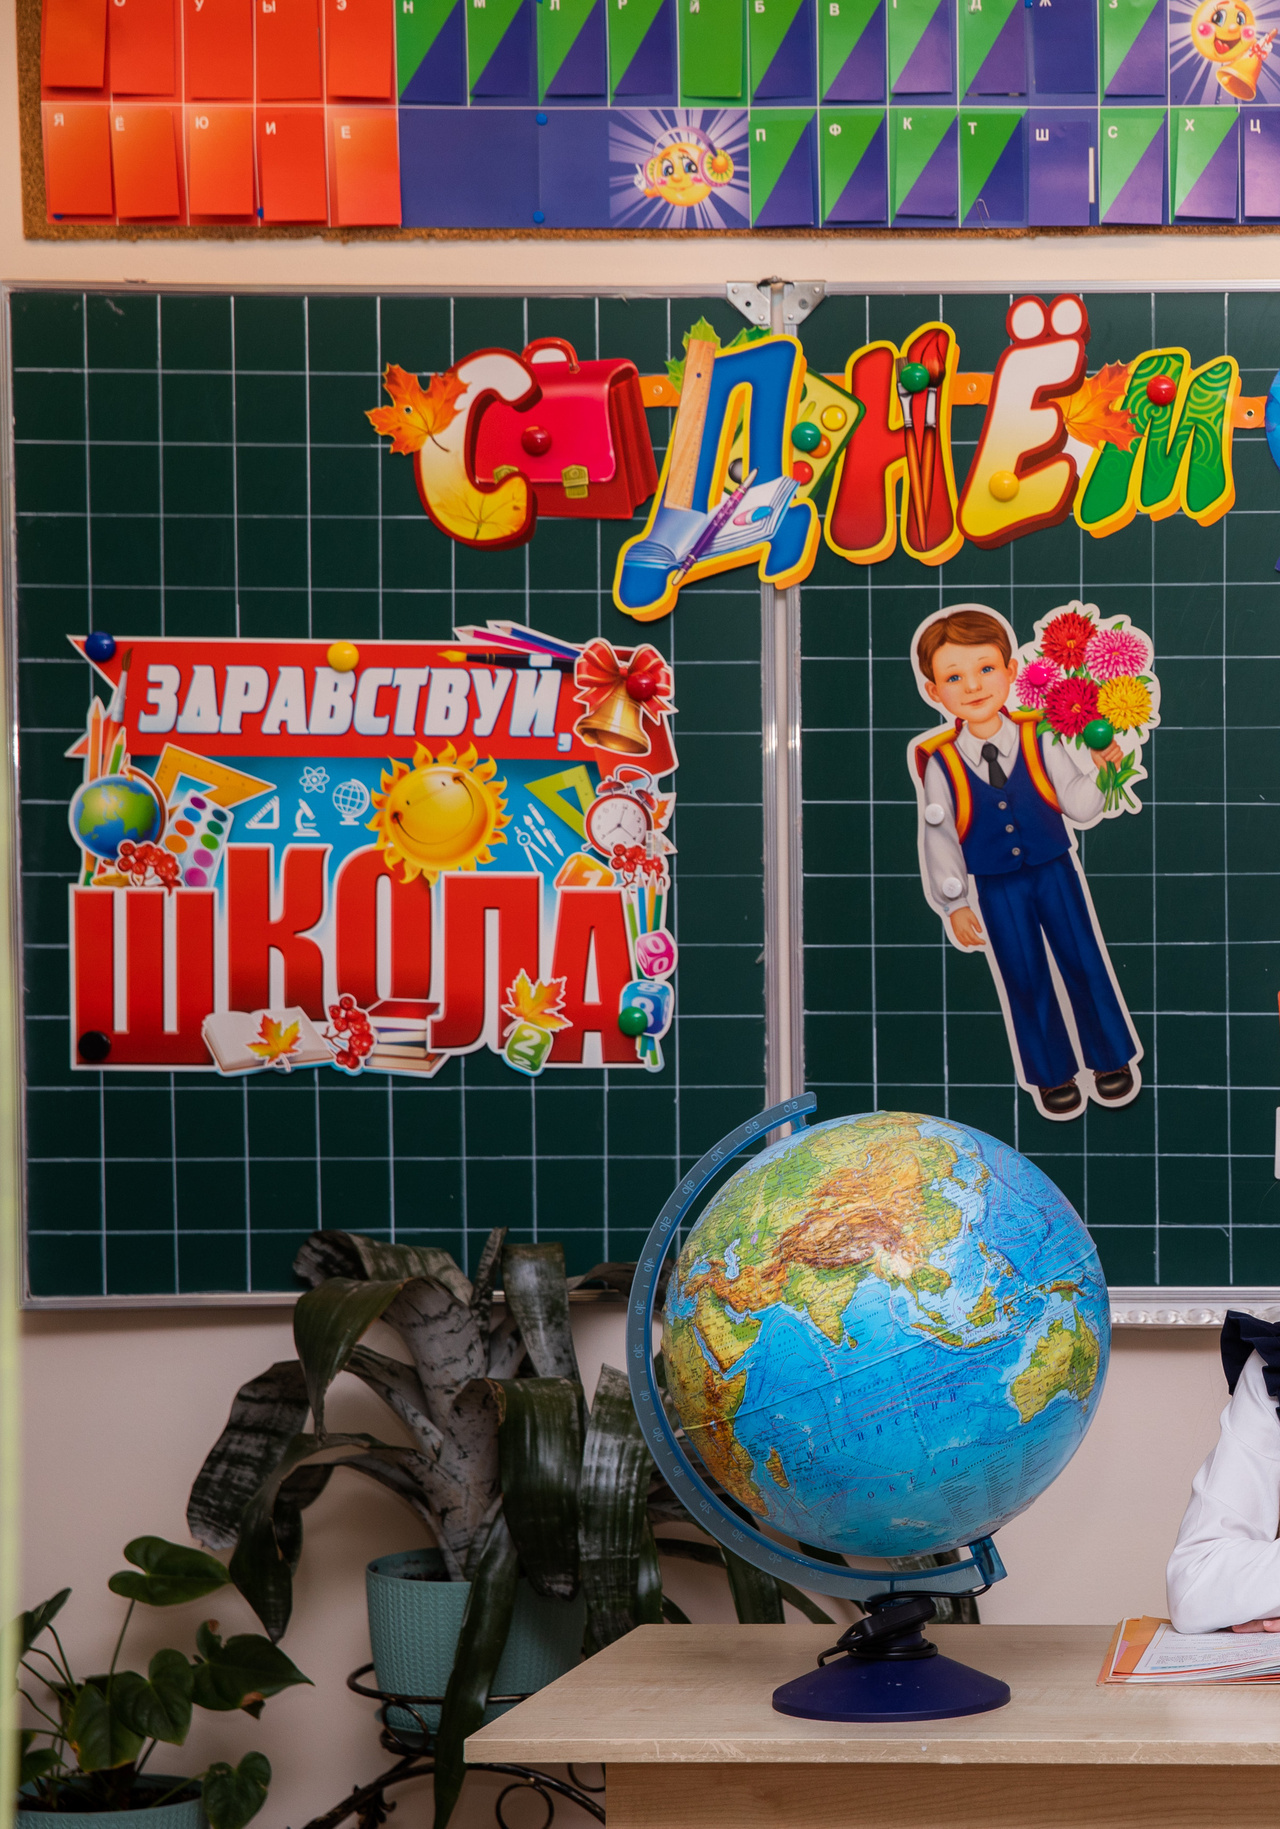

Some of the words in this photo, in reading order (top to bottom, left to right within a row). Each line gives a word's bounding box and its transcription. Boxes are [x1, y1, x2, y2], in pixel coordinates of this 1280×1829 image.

[262, 0, 276, 13] Ы
[336, 0, 347, 11] Э
[403, 1, 414, 14] Н
[754, 0, 765, 13] Б
[829, 3, 839, 16] В
[53, 113, 65, 127] Я
[115, 116, 126, 132] Ё
[195, 116, 209, 130] Ю
[902, 117, 913, 130] К
[1184, 118, 1195, 132] Х
[1249, 118, 1262, 134] Ц
[265, 121, 277, 135] И
[340, 125, 351, 139] Е
[755, 128, 766, 142] П
[828, 123, 842, 137] Ф
[967, 122, 978, 135] Т
[1035, 128, 1050, 142] Ш
[1107, 125, 1118, 139] С
[414, 348, 542, 551] С
[613, 294, 1241, 622] ДНЁМ
[138, 653, 572, 753] ЗДРАВСТВУЙ,
[69, 843, 648, 1066] ШКОЛА
[514, 1029, 542, 1056] 2
[866, 1456, 959, 1500] ОКЕАН
